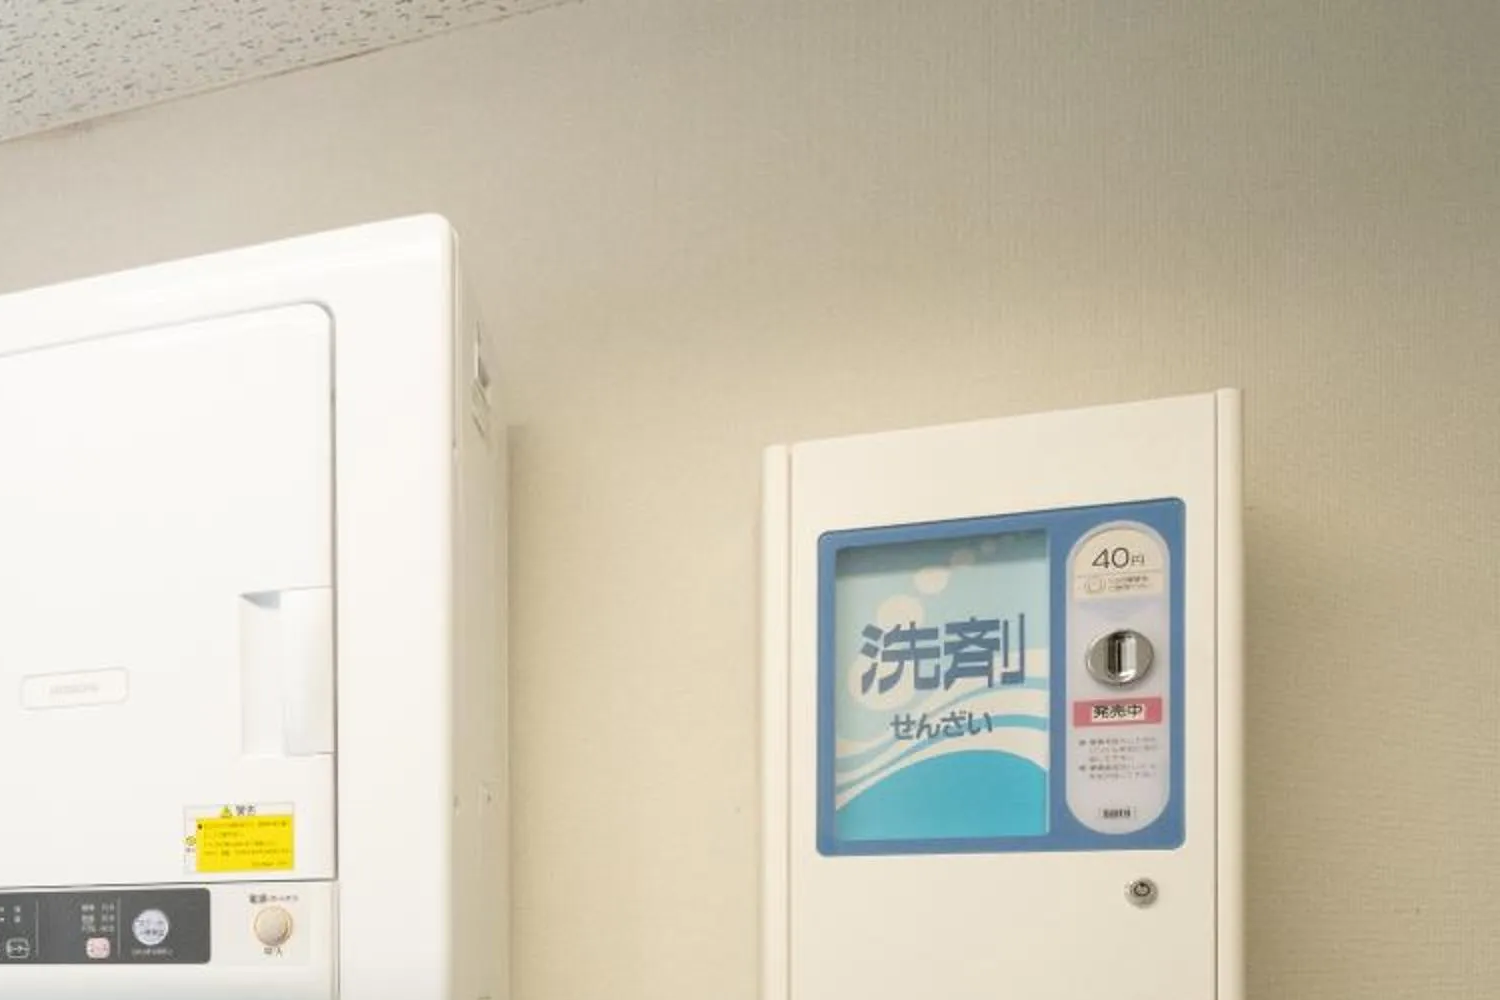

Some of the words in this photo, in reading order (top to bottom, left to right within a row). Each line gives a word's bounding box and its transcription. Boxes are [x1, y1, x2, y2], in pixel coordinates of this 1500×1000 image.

[861, 613, 1025, 694] 洗剤
[889, 711, 994, 741] せんざい
